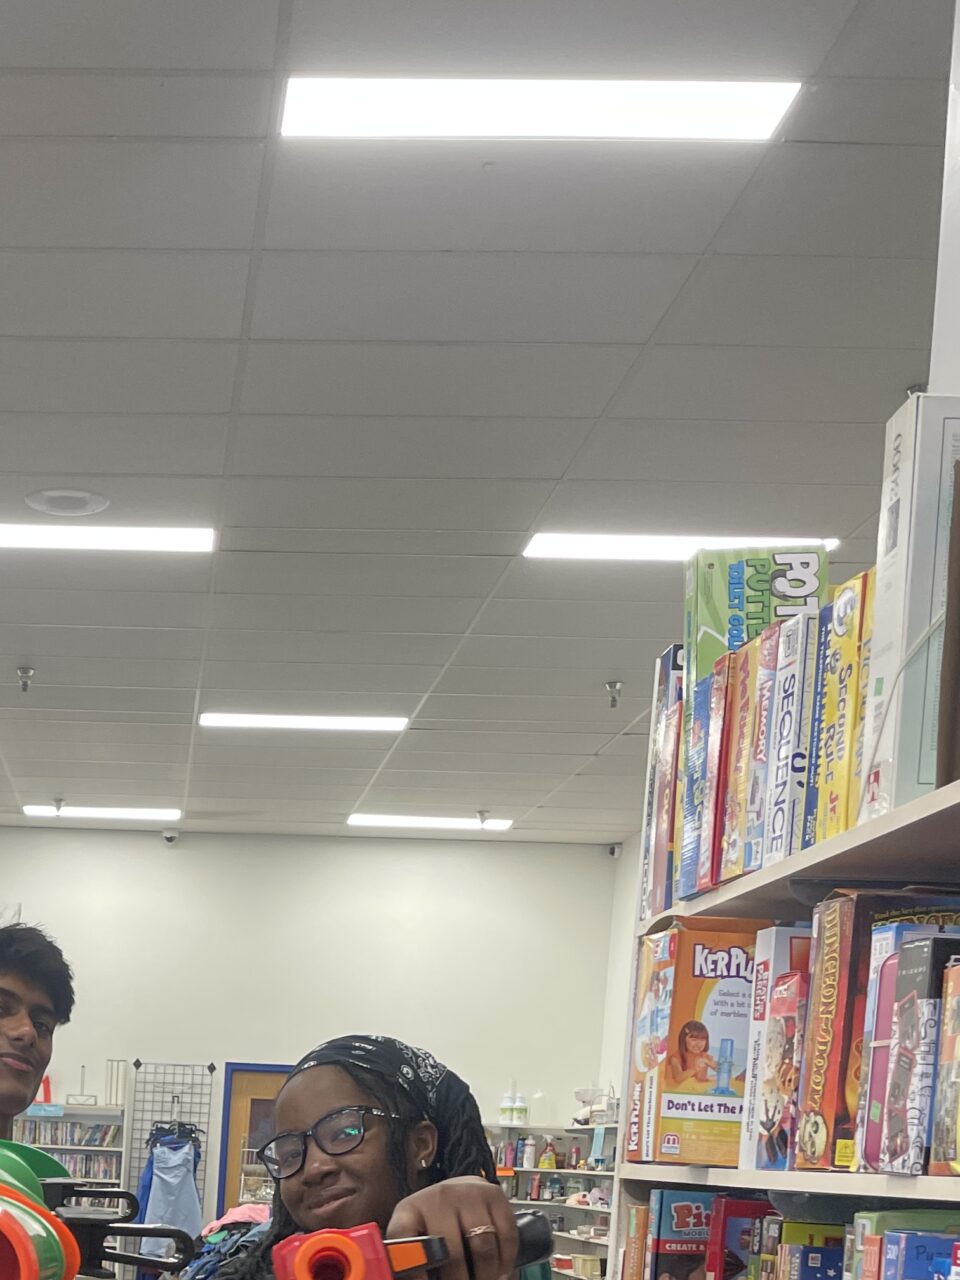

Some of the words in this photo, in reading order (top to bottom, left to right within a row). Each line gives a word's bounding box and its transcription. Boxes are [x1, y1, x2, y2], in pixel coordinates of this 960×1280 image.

[728, 560, 745, 611] TOILET
[753, 679, 774, 762] MEMORY
[837, 663, 853, 761] SECOND
[771, 673, 797, 853] SEQUENCE
[824, 723, 836, 785] RULE
[819, 902, 840, 1018] DUNGEON
[667, 1100, 696, 1111] Don't
[698, 1101, 714, 1113] Let
[717, 1103, 737, 1114] The
[808, 1035, 832, 1111] DOOM
